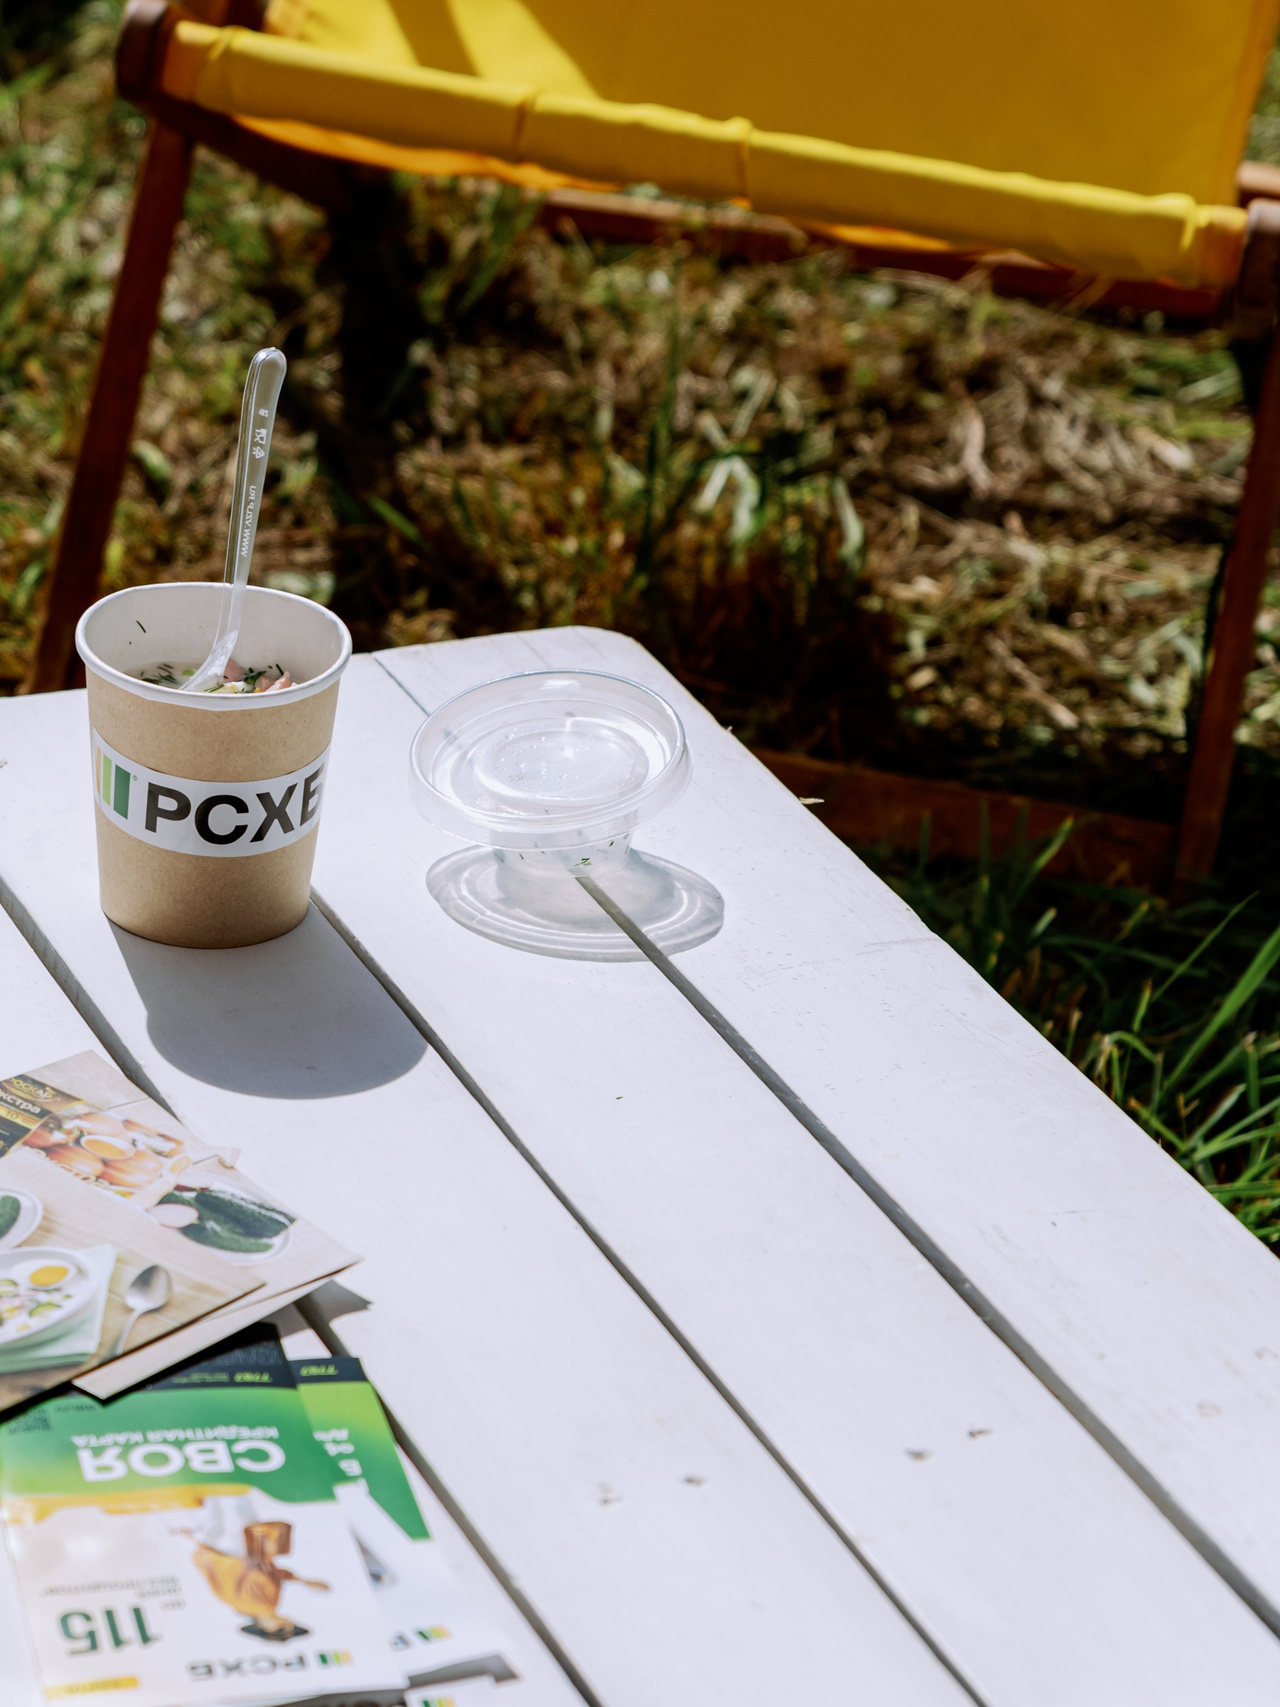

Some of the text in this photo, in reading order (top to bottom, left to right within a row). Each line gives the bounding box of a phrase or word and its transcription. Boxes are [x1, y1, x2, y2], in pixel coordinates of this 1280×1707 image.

[144, 762, 325, 845] РСХБ
[71, 1426, 280, 1447] КРЕДИТНАЯ КАРТА
[77, 1439, 286, 1482] СВОЯ
[60, 1606, 161, 1656] 115
[190, 1652, 308, 1679] РСХБ
